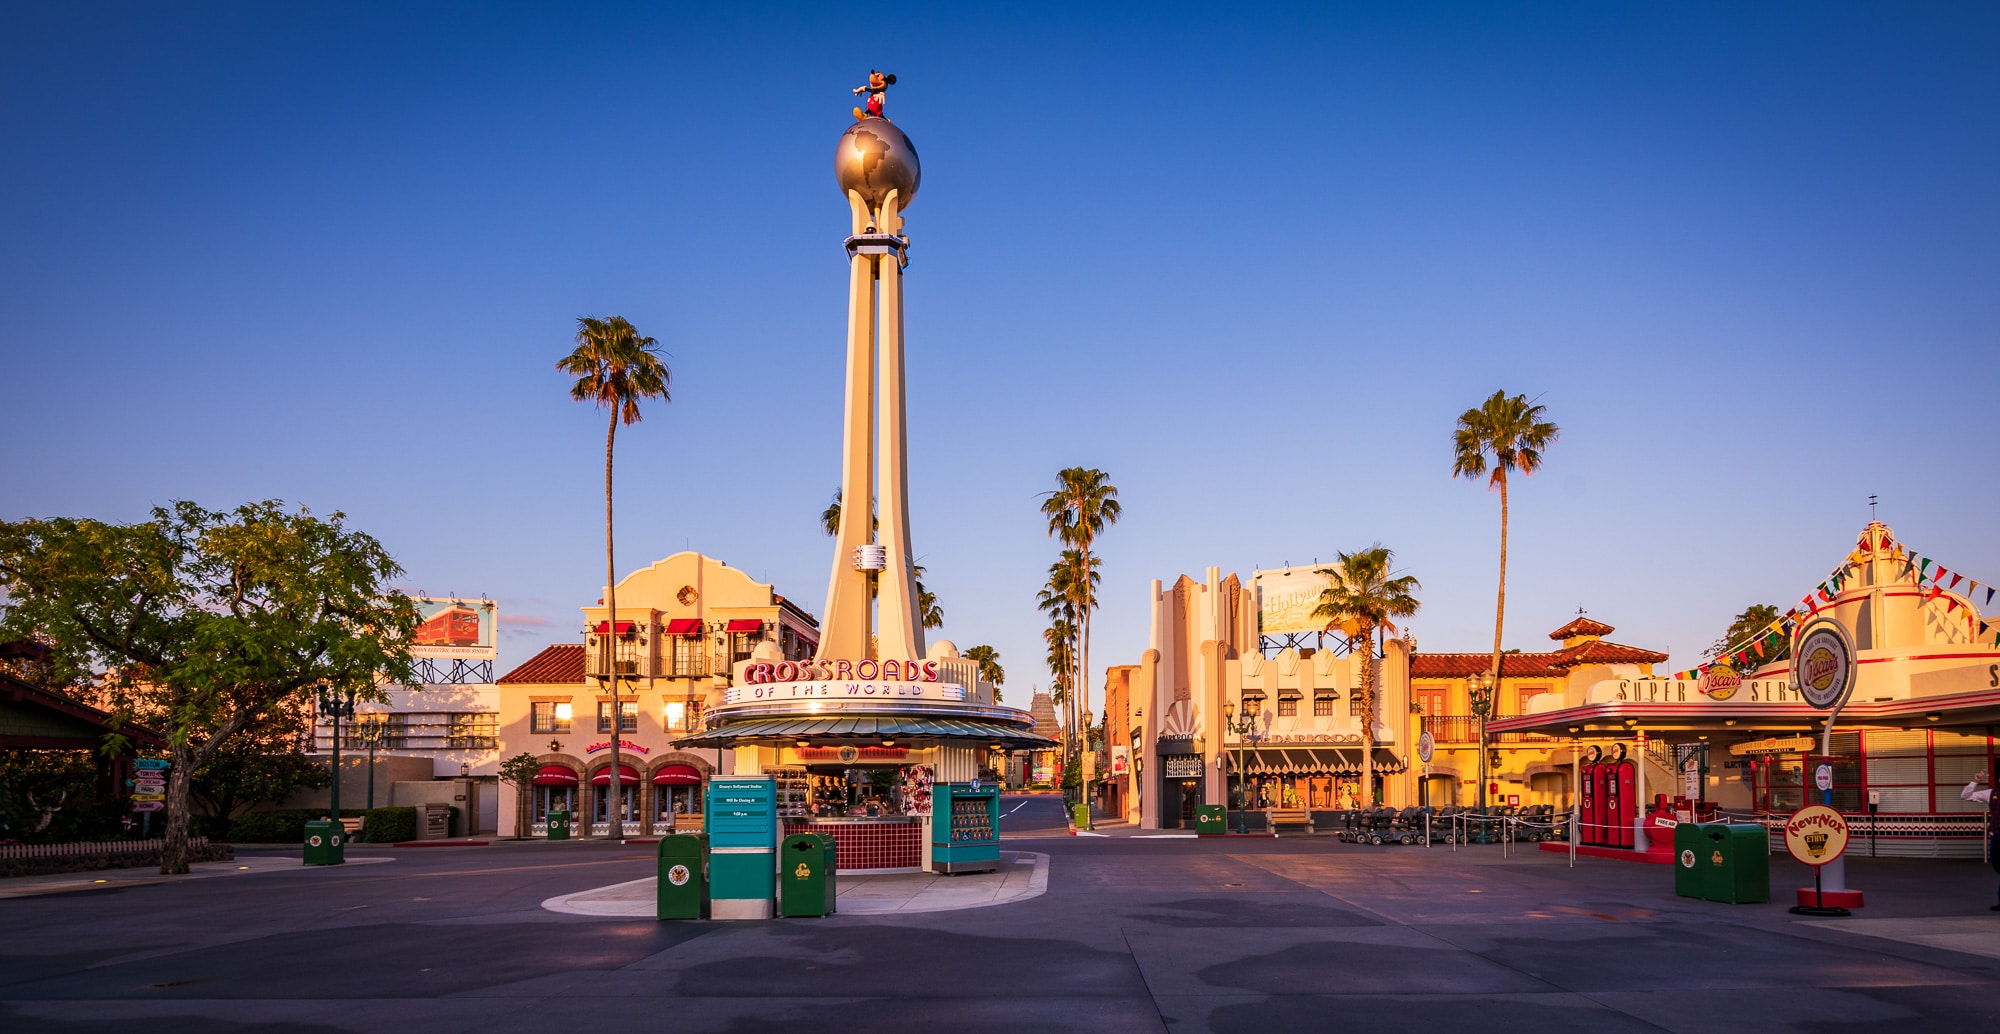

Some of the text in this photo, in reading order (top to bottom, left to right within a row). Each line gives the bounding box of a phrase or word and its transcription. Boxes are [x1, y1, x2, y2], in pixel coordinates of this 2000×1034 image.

[743, 658, 939, 685] CROSSROADS
[1804, 652, 1838, 687] Oscar's
[754, 683, 924, 698] OF THE WORLD
[1620, 681, 1686, 702] SUPER
[1698, 670, 1742, 695] Oscar's
[1271, 733, 1364, 743] DARKROO
[1657, 818, 1668, 826] FREE
[1788, 813, 1845, 838] NevrNox
[1806, 834, 1827, 843] ETHYL
